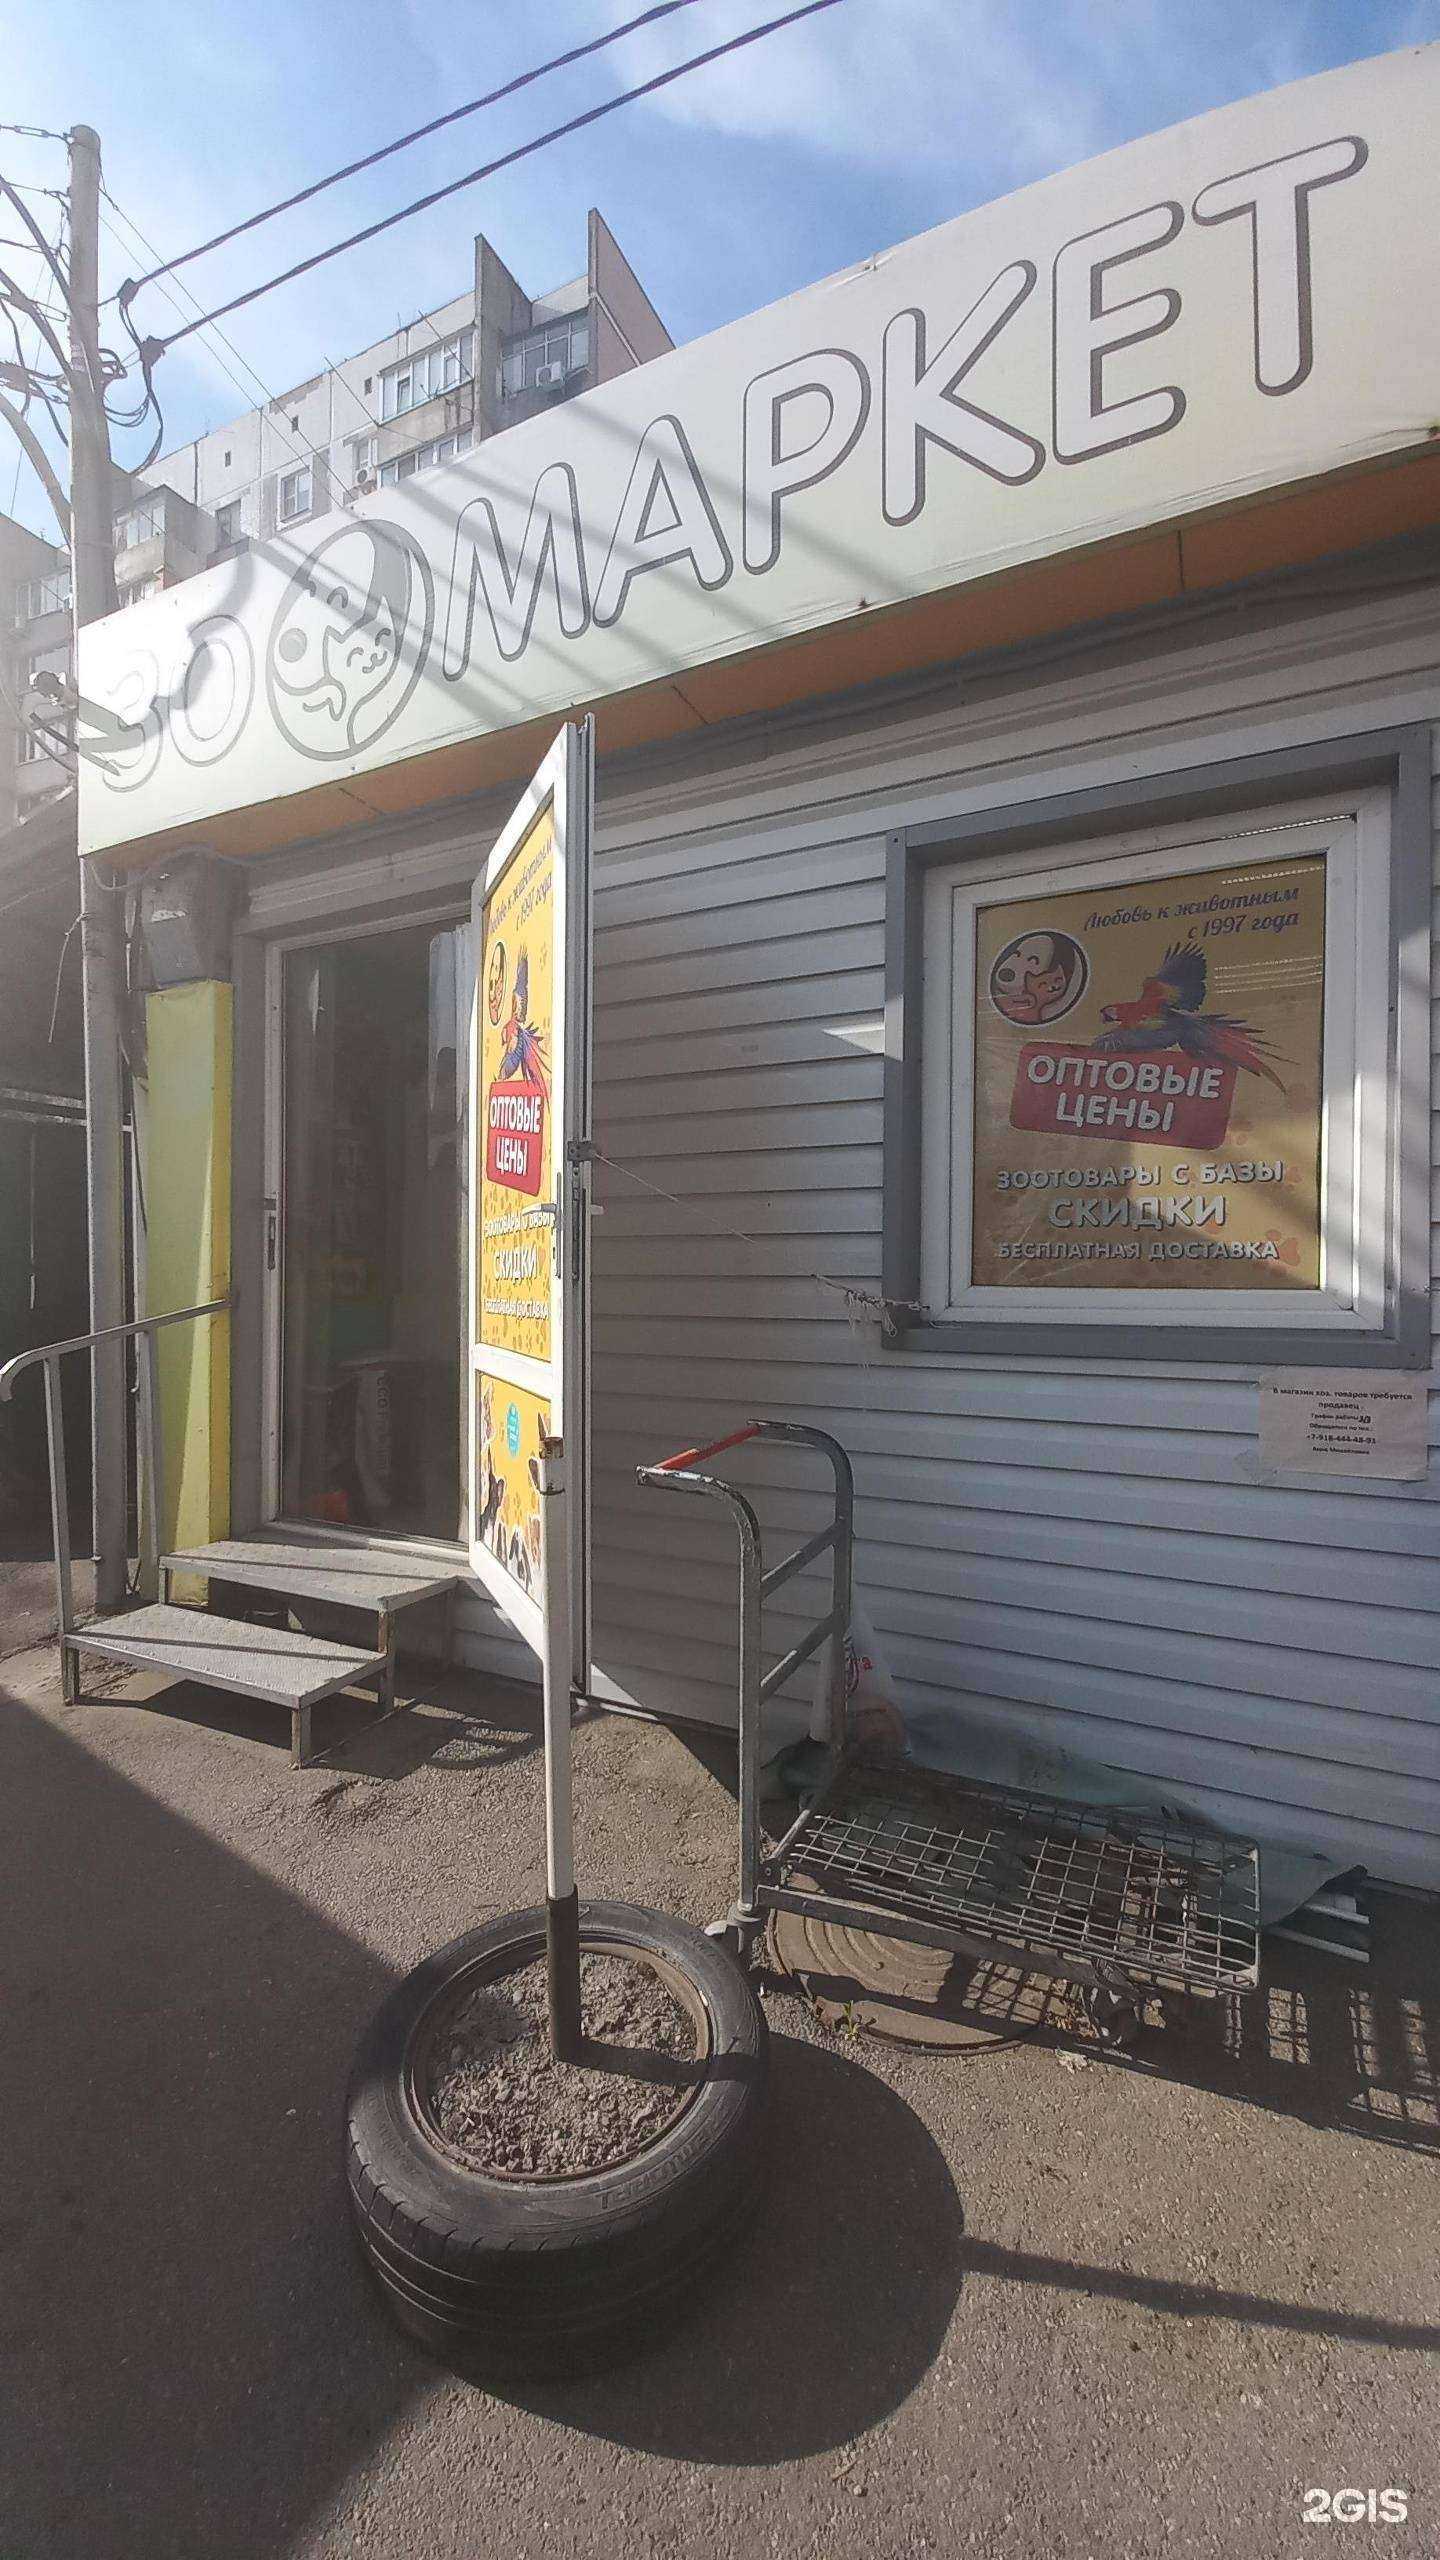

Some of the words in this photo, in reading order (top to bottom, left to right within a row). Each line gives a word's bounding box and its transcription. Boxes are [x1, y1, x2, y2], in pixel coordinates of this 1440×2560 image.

[1084, 905, 1152, 932] Любовь
[1157, 905, 1170, 919] к
[1174, 888, 1300, 917] животным
[1188, 926, 1198, 940] с
[1203, 914, 1247, 938] 1997
[1251, 911, 1300, 933] года
[1026, 1054, 1225, 1099] ОПТОВЫЕ
[490, 1094, 541, 1135] ОПТОВЫЕ
[1055, 1092, 1175, 1132] ЦЕНЫ
[496, 1135, 528, 1177] ЦЕНЫ
[996, 1164, 1162, 1190] ЗООТОВАРЫ
[1172, 1164, 1191, 1185] С
[1200, 1160, 1284, 1185] БАЗЫ
[1049, 1194, 1227, 1230] СКИДКИ
[494, 1243, 538, 1285] СКИДКИ
[997, 1239, 1142, 1260] БЕСПЛАТНАЯ
[1149, 1239, 1281, 1262] ДОСТАВКА
[1280, 1388, 1314, 1396] магазин
[1334, 1391, 1368, 1399] товаров
